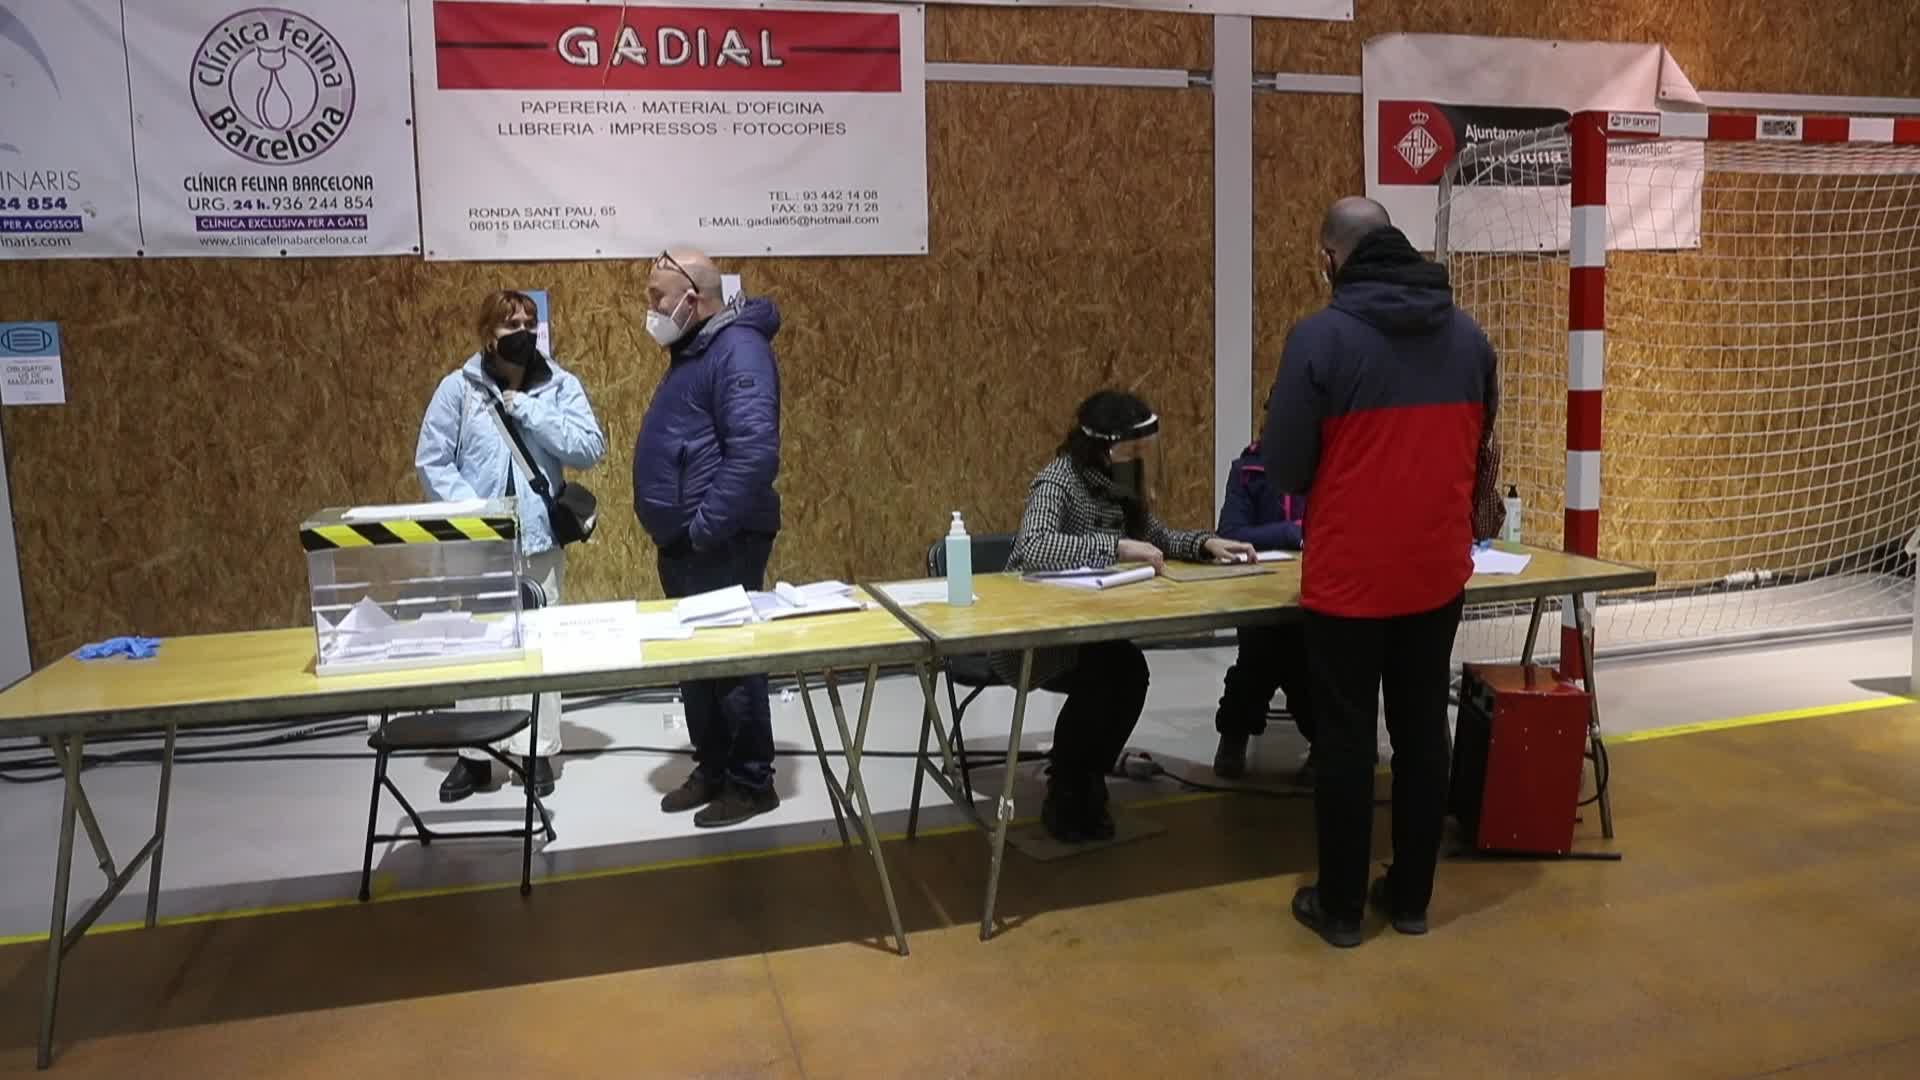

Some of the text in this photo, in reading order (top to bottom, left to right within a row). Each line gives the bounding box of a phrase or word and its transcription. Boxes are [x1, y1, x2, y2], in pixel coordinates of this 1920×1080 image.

[198, 17, 343, 88] Clínica Felina
[557, 26, 784, 67] GADIAL
[521, 101, 824, 115] PAPERERIA MATERIAL D'OFICINA
[209, 106, 344, 160] Barcelona
[498, 122, 847, 136] LLIBRERIA IMPRESSOS FOTOCOPIES
[184, 172, 374, 192] CLÍNICA FELINA BARCELONA
[803, 190, 817, 201] 93
[821, 190, 842, 201] 442
[847, 190, 860, 200] 14
[863, 190, 878, 200] 08
[27, 196, 67, 211] 854
[188, 196, 230, 211] URG.
[233, 199, 253, 210] 24
[272, 196, 303, 211] 936
[309, 196, 338, 210] 244
[344, 196, 374, 210] 854
[803, 203, 818, 213] 93
[822, 202, 843, 213] 329
[847, 202, 860, 212] 71
[864, 202, 879, 212] 28
[469, 207, 520, 218] RONDA
[524, 206, 561, 217] SANT
[601, 205, 616, 216] 65
[3, 218, 80, 230] PER A GOSSOS
[249, 218, 305, 230] EXCLUSIVA
[307, 218, 326, 228] PER
[327, 218, 336, 228] A
[337, 217, 366, 228] GATS
[469, 219, 600, 231] 08015 BARCELONA
[199, 234, 368, 248] www.clinicafelinabarcelona.cat
